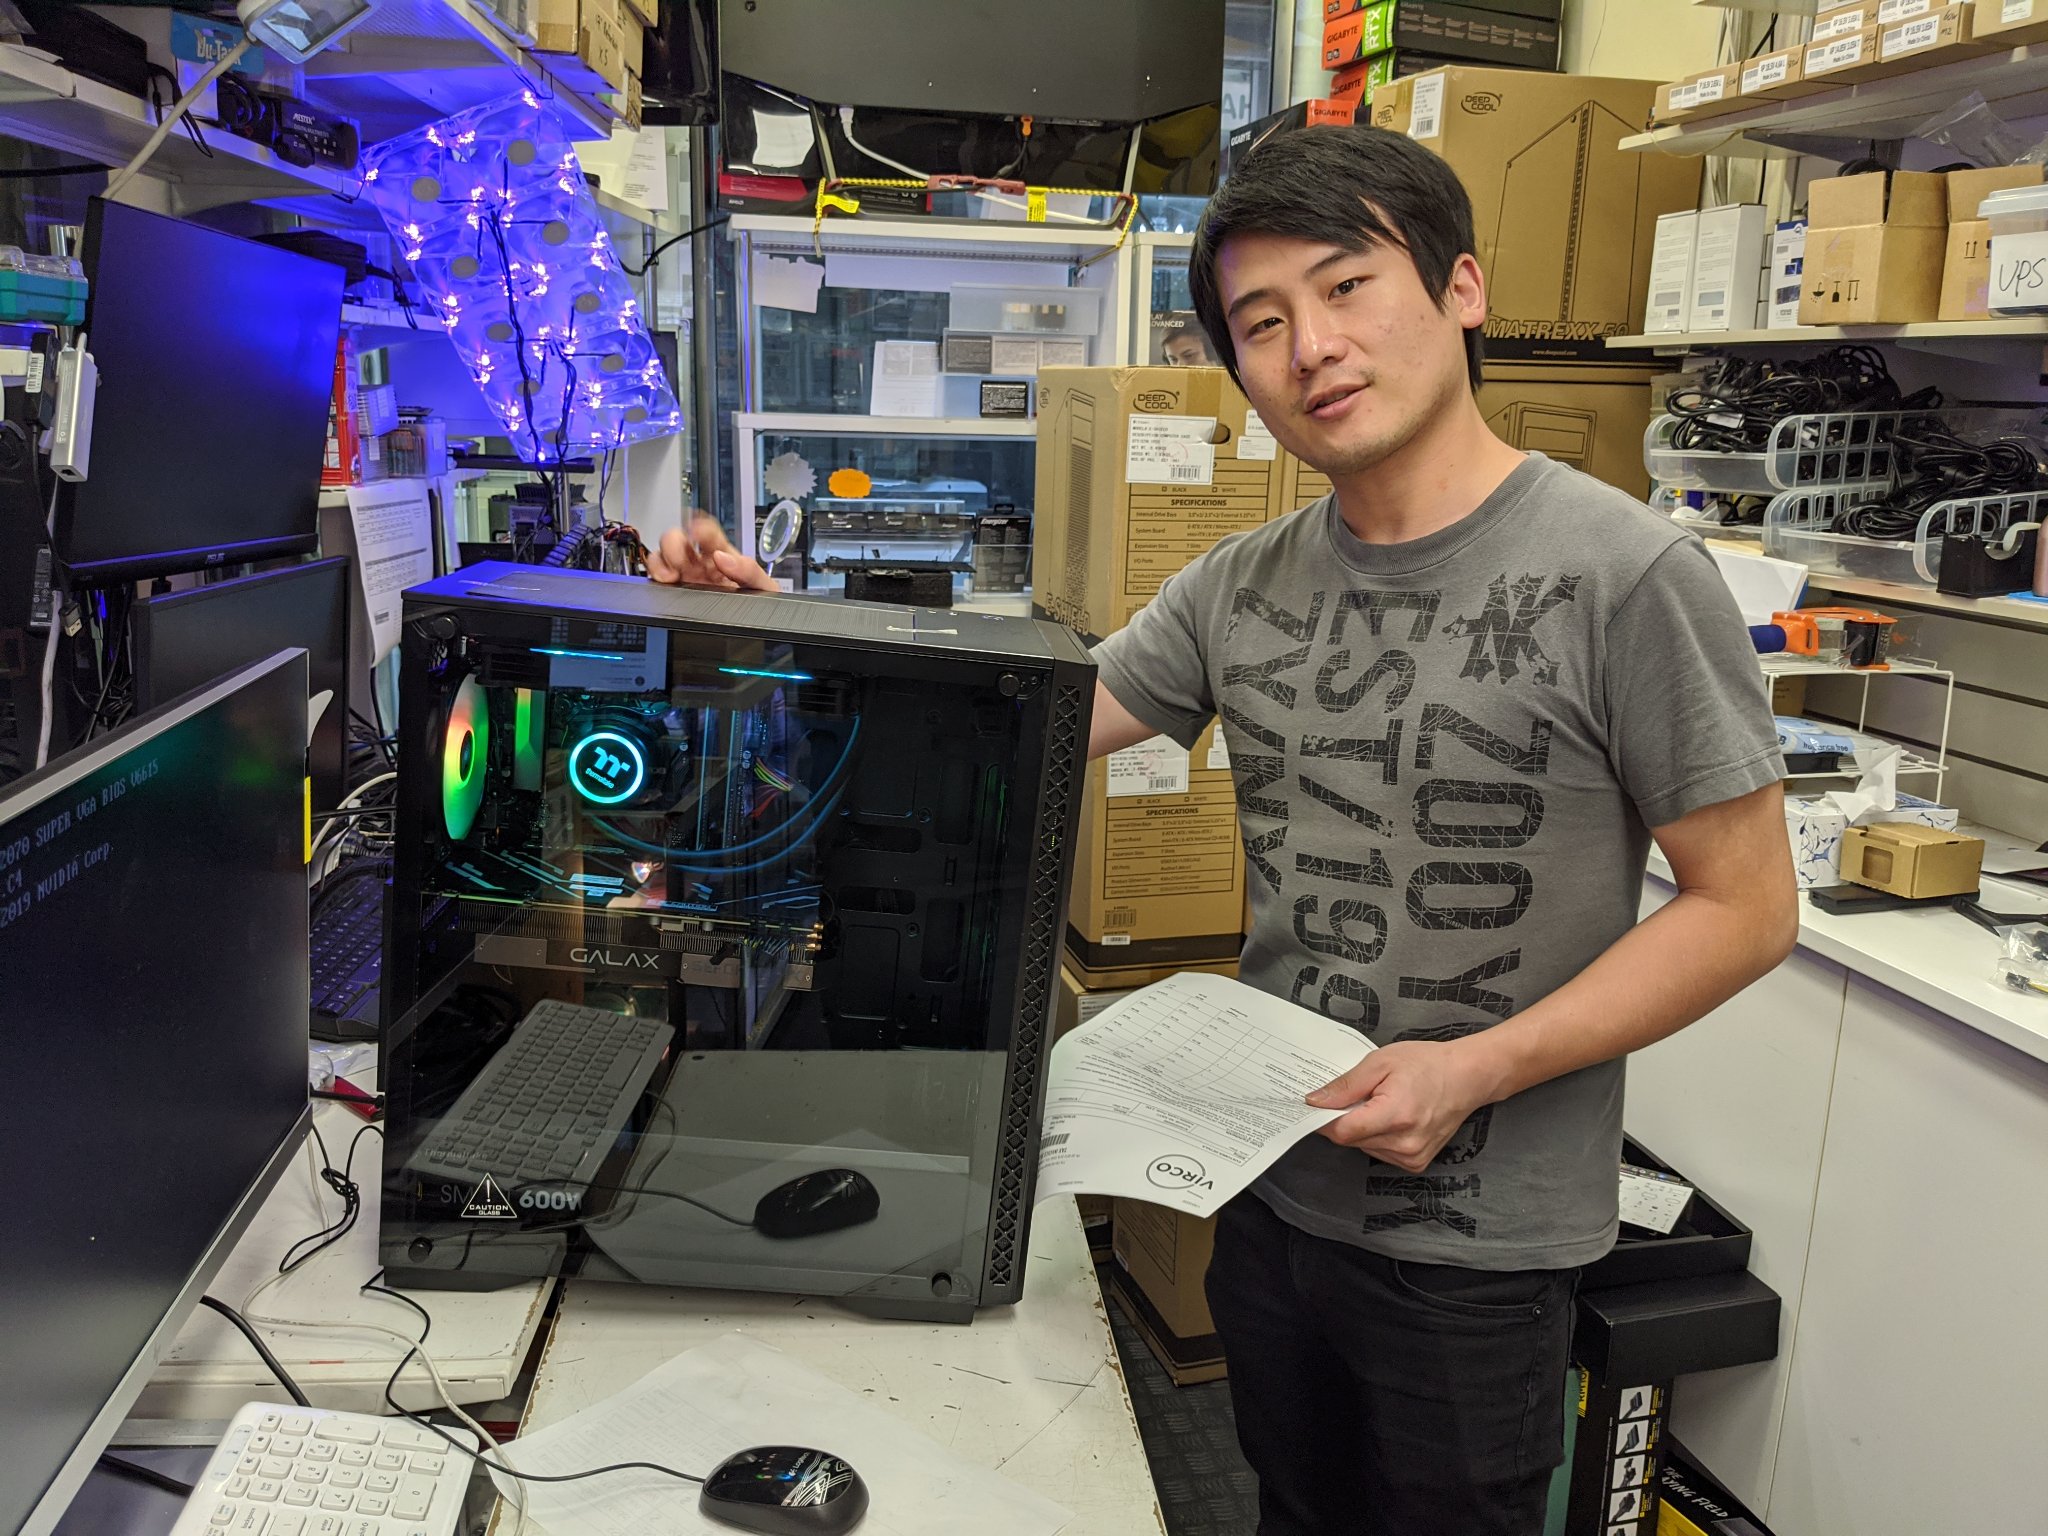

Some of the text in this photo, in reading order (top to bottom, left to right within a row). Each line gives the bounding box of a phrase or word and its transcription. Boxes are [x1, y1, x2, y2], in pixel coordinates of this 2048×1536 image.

[1327, 26, 1358, 43] GIGABYTE
[1370, 7, 1382, 49] RTX
[1334, 79, 1360, 95] GIGABYTE
[1314, 108, 1348, 118] GIGABYTE
[1471, 103, 1497, 112] COOL
[1231, 131, 1251, 146] GIGABYTE
[1999, 257, 2047, 298] UPS
[1486, 320, 1600, 341] MATREXX
[1137, 393, 1166, 402] DEEP
[1145, 402, 1175, 410] COOL
[1171, 499, 1227, 507] SPECIFICATIONS
[1145, 807, 1199, 816] SPECIFICATIONS
[0, 838, 30, 870] 2070
[35, 812, 71, 848] SUPER
[76, 797, 97, 821] VGA
[102, 777, 126, 807] BIOS
[0, 893, 31, 929] 2019
[37, 862, 79, 900] NVIDIA
[570, 947, 660, 970] GALAX
[1363, 703, 1553, 1239] ZOO YK
[1156, 1162, 1213, 1191] VIRCO
[519, 1189, 582, 1211] 600W
[1691, 1497, 1729, 1517] FIELD
